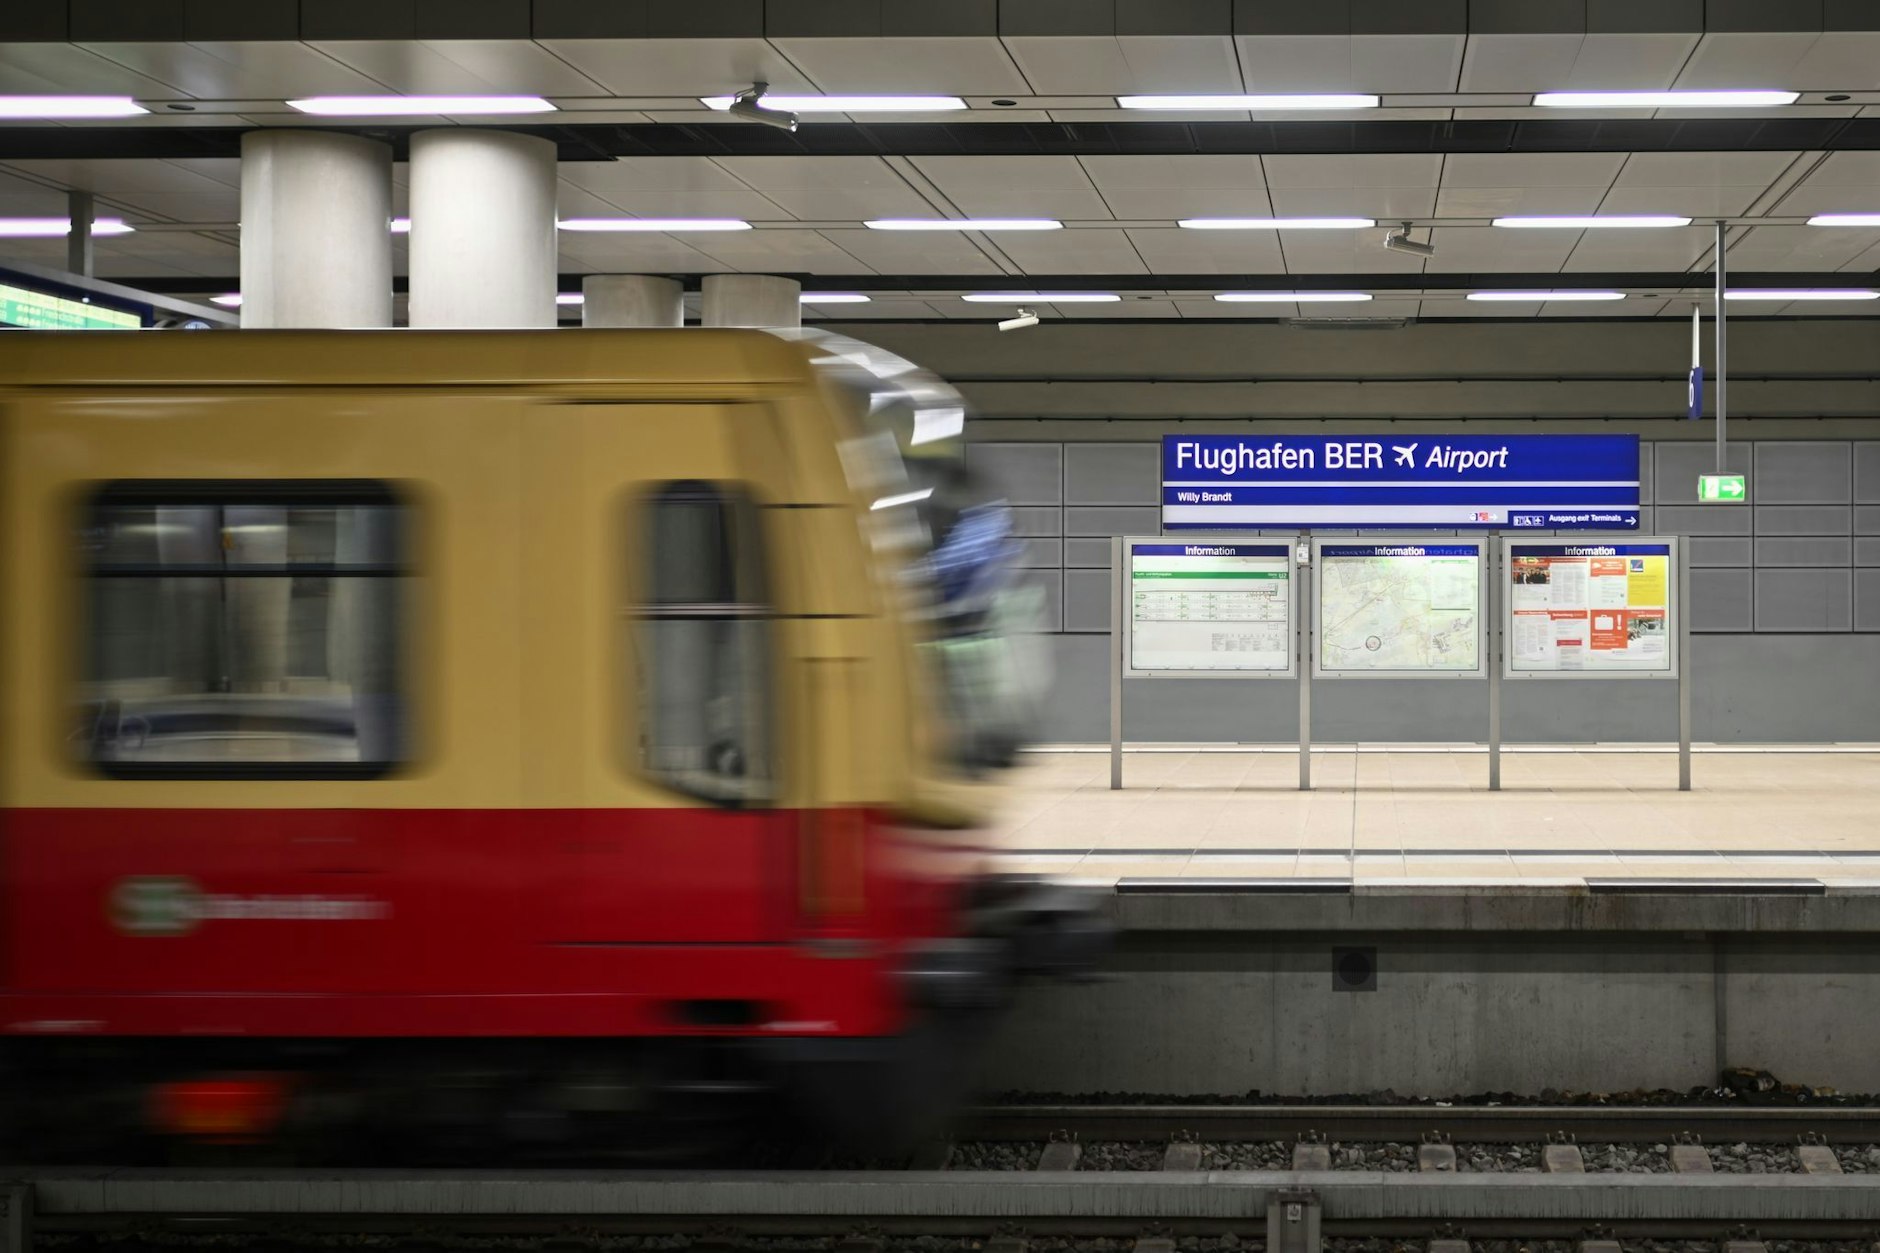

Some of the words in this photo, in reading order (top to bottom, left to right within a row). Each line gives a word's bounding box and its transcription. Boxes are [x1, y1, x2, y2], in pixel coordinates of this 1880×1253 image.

[1177, 442, 1315, 475] Flughafen
[1325, 442, 1384, 469] BER
[1425, 446, 1509, 473] Airport
[1177, 492, 1200, 503] Willy
[1202, 492, 1232, 502] Brandt
[1549, 514, 1576, 523] Ausgang
[1577, 514, 1590, 522] exit
[1591, 514, 1622, 522] Terminals
[1185, 546, 1236, 556] Information
[1374, 546, 1426, 556] Information
[1565, 546, 1616, 556] Information
